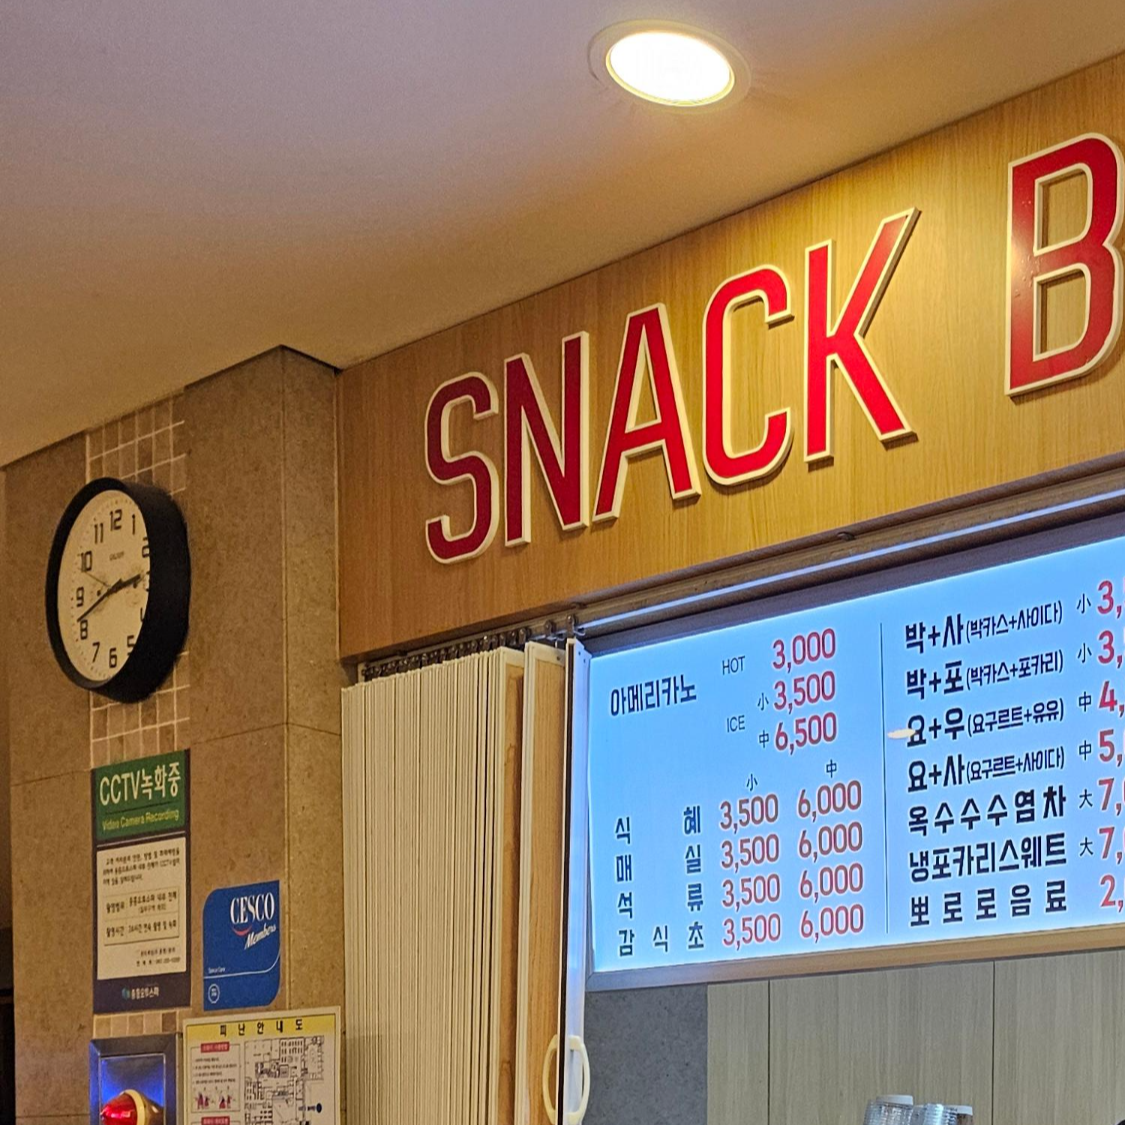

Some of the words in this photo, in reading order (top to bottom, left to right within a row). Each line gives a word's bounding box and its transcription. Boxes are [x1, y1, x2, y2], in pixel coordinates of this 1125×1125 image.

[424, 206, 921, 566] SNACK
[94, 522, 104, 544] 11
[109, 509, 122, 531] 12
[80, 551, 93, 572] 10
[76, 586, 85, 607] 9
[79, 619, 88, 640] 8
[92, 642, 100, 662] 7
[108, 648, 117, 668] 6
[722, 656, 745, 675] HOT
[772, 628, 836, 672] 3,000
[610, 674, 697, 716] 아메리카노
[773, 670, 836, 714] 3,500
[1078, 691, 1092, 712] 中
[727, 716, 746, 733] ICE
[758, 730, 770, 749] 中
[775, 712, 837, 755] 6,500
[1079, 740, 1092, 760] 中
[100, 762, 181, 806] CCTV녹화중
[719, 794, 779, 833] 3,500
[797, 780, 862, 823] 6,000
[908, 785, 1067, 837] 옥수수수염차
[721, 834, 780, 873] 3,500
[798, 821, 863, 863] 6,000
[909, 832, 1068, 883] 냉포카리스웨트
[230, 892, 275, 925] CESCO
[722, 873, 780, 912] 3,500
[799, 863, 864, 904] 6,000
[910, 880, 1067, 927] 뽀로로음료
[244, 922, 277, 950] Members
[722, 913, 781, 950] 3,500
[800, 904, 864, 943] 6,000
[220, 1019, 303, 1036] 피난안내도
